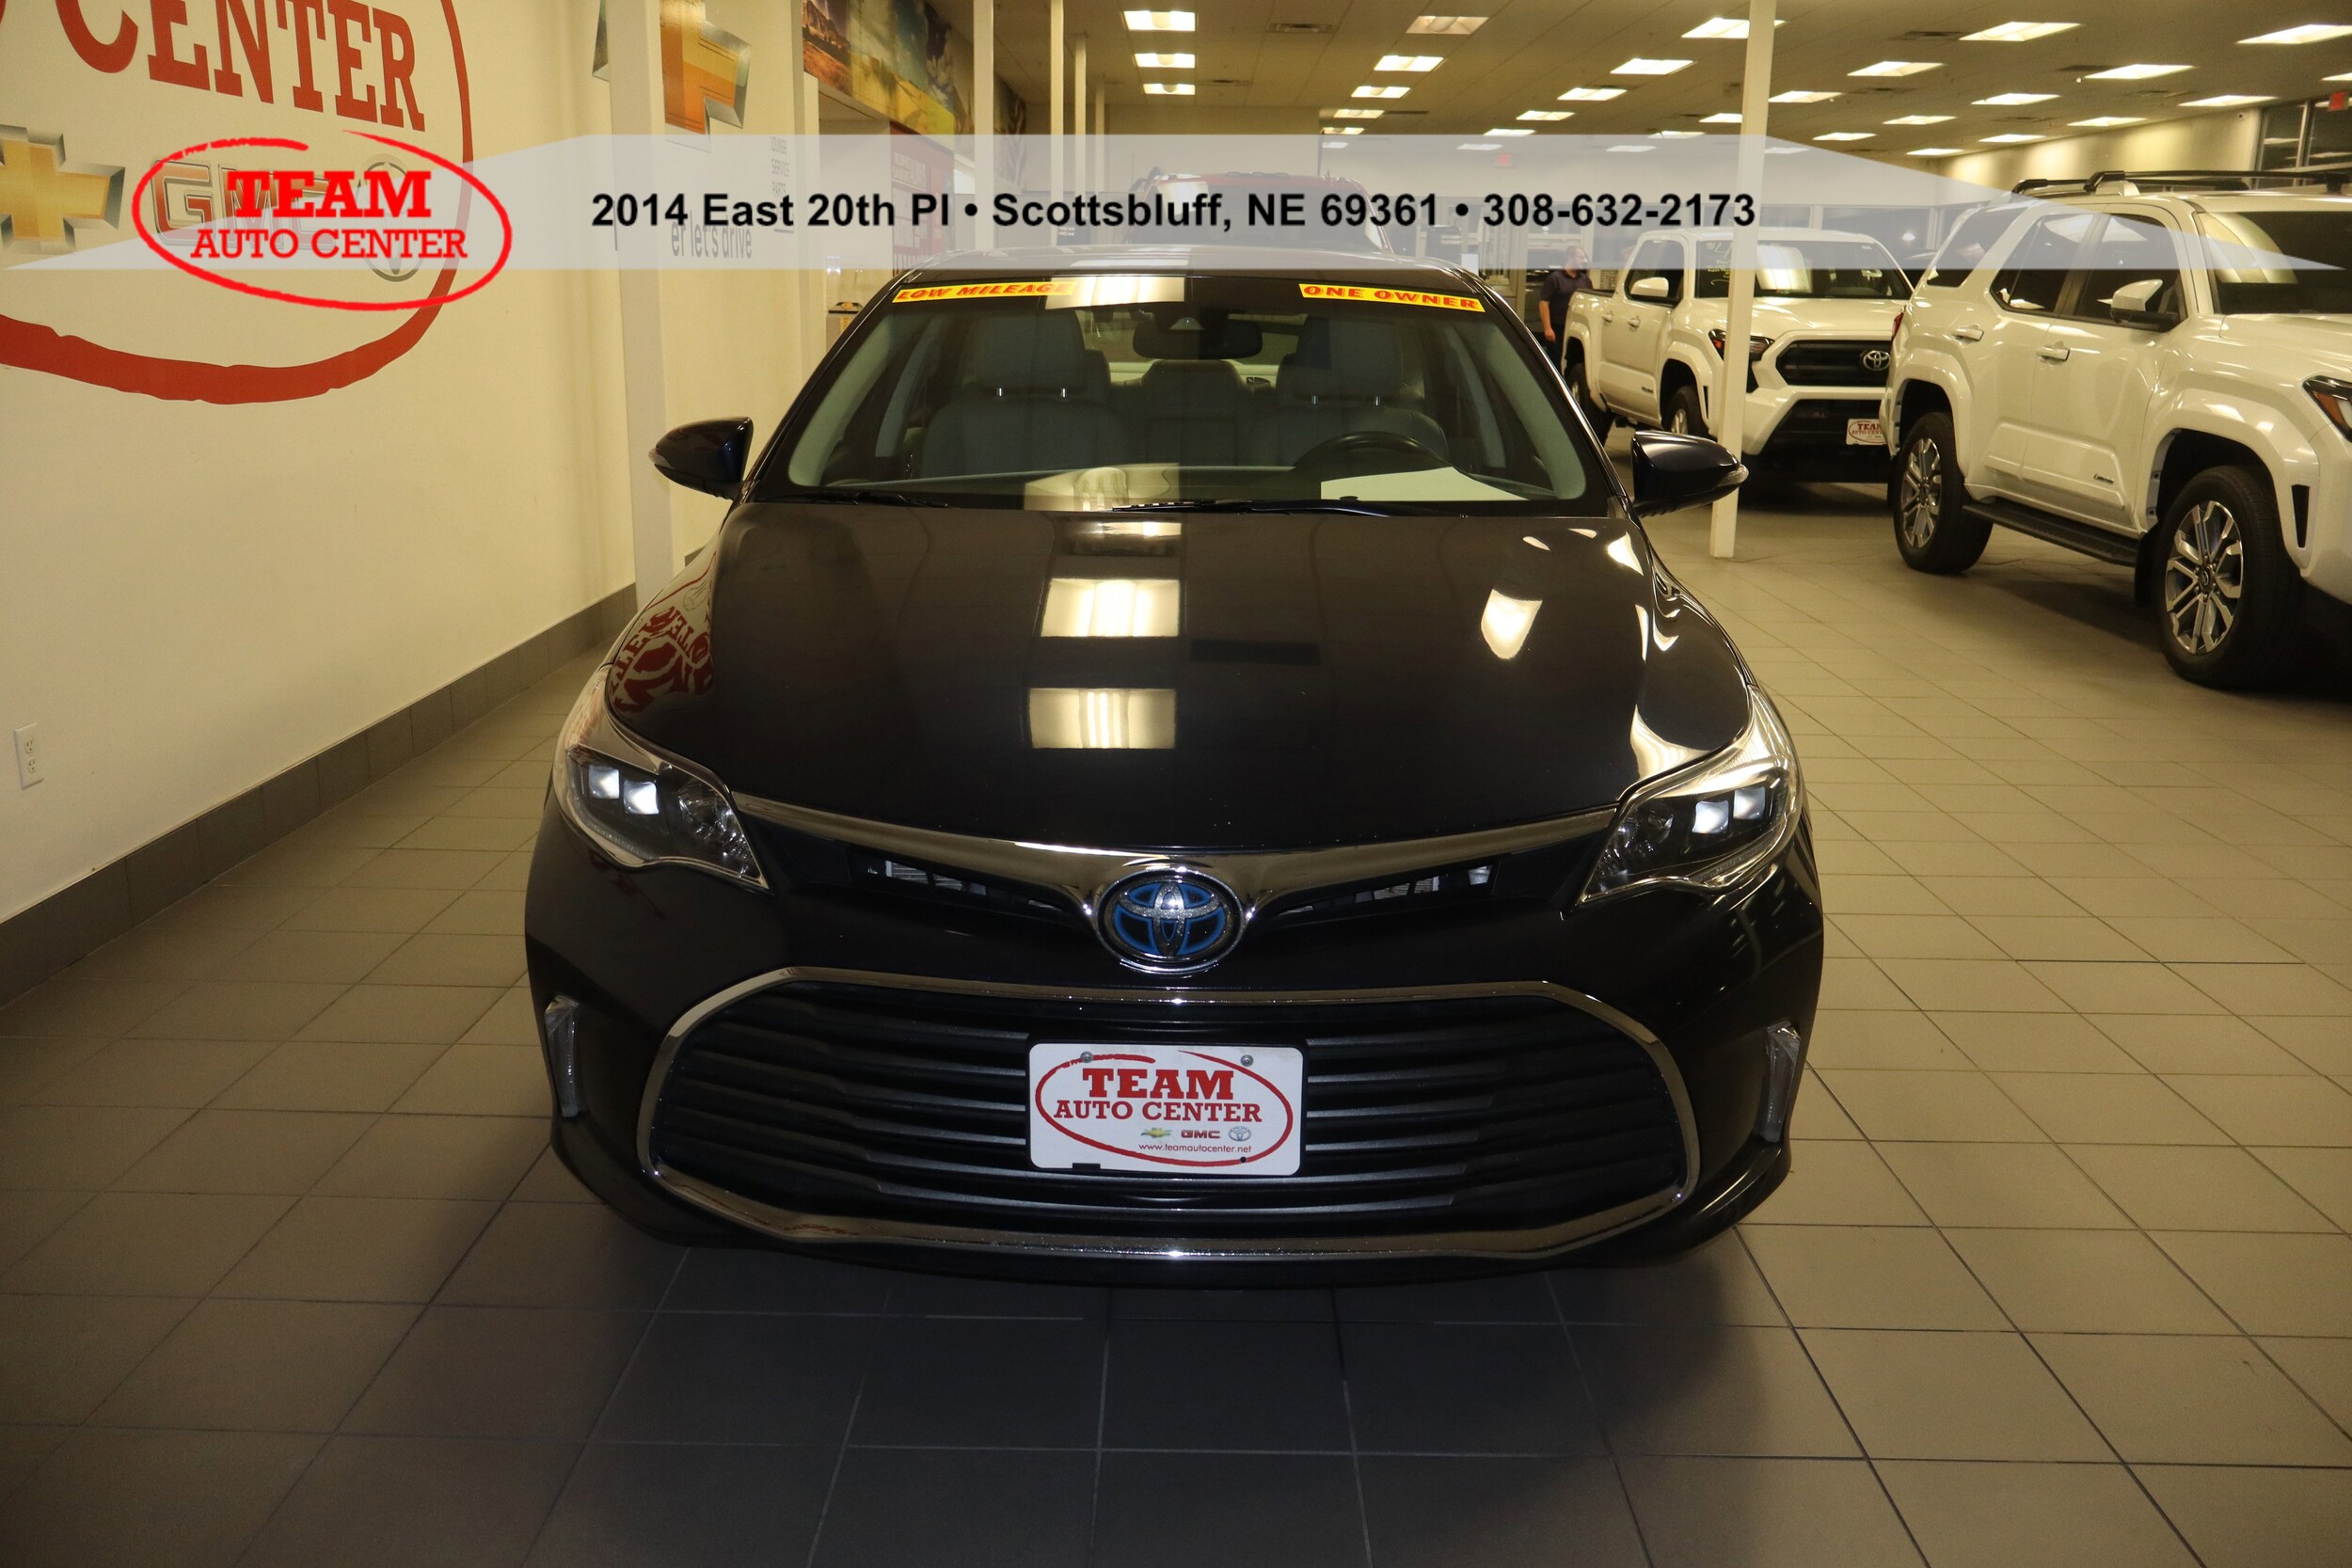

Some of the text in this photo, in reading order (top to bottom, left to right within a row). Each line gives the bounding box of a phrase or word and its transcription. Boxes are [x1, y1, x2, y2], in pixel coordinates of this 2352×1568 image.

[897, 283, 1073, 300] LOW MILEAGE
[1303, 285, 1479, 309] ONE OWNER
[1082, 1068, 1234, 1100] TEAM
[1054, 1100, 1263, 1123] AUTO CENTER
[1181, 1130, 1221, 1139] GMC
[1138, 1142, 1252, 1153] www.teamautocenter.net
